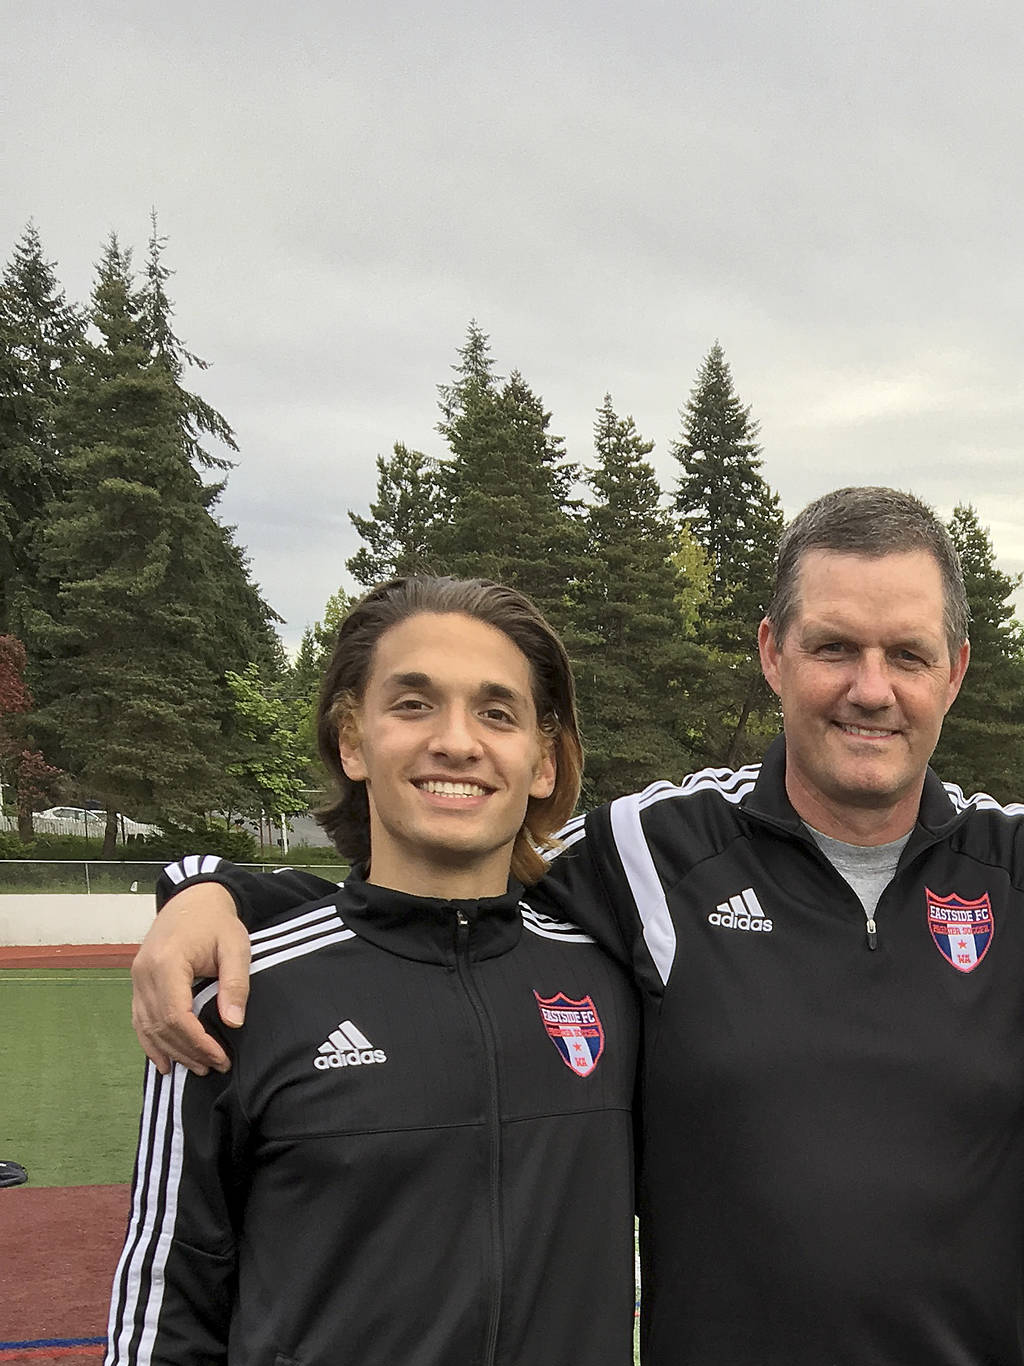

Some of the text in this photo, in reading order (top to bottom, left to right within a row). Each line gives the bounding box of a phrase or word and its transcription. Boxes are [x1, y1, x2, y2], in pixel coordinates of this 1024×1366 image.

[708, 911, 774, 933] adidas
[930, 905, 989, 922] EASTSIDE FC
[541, 1007, 596, 1024] EASTSIDE FC
[313, 1048, 388, 1070] adidas
